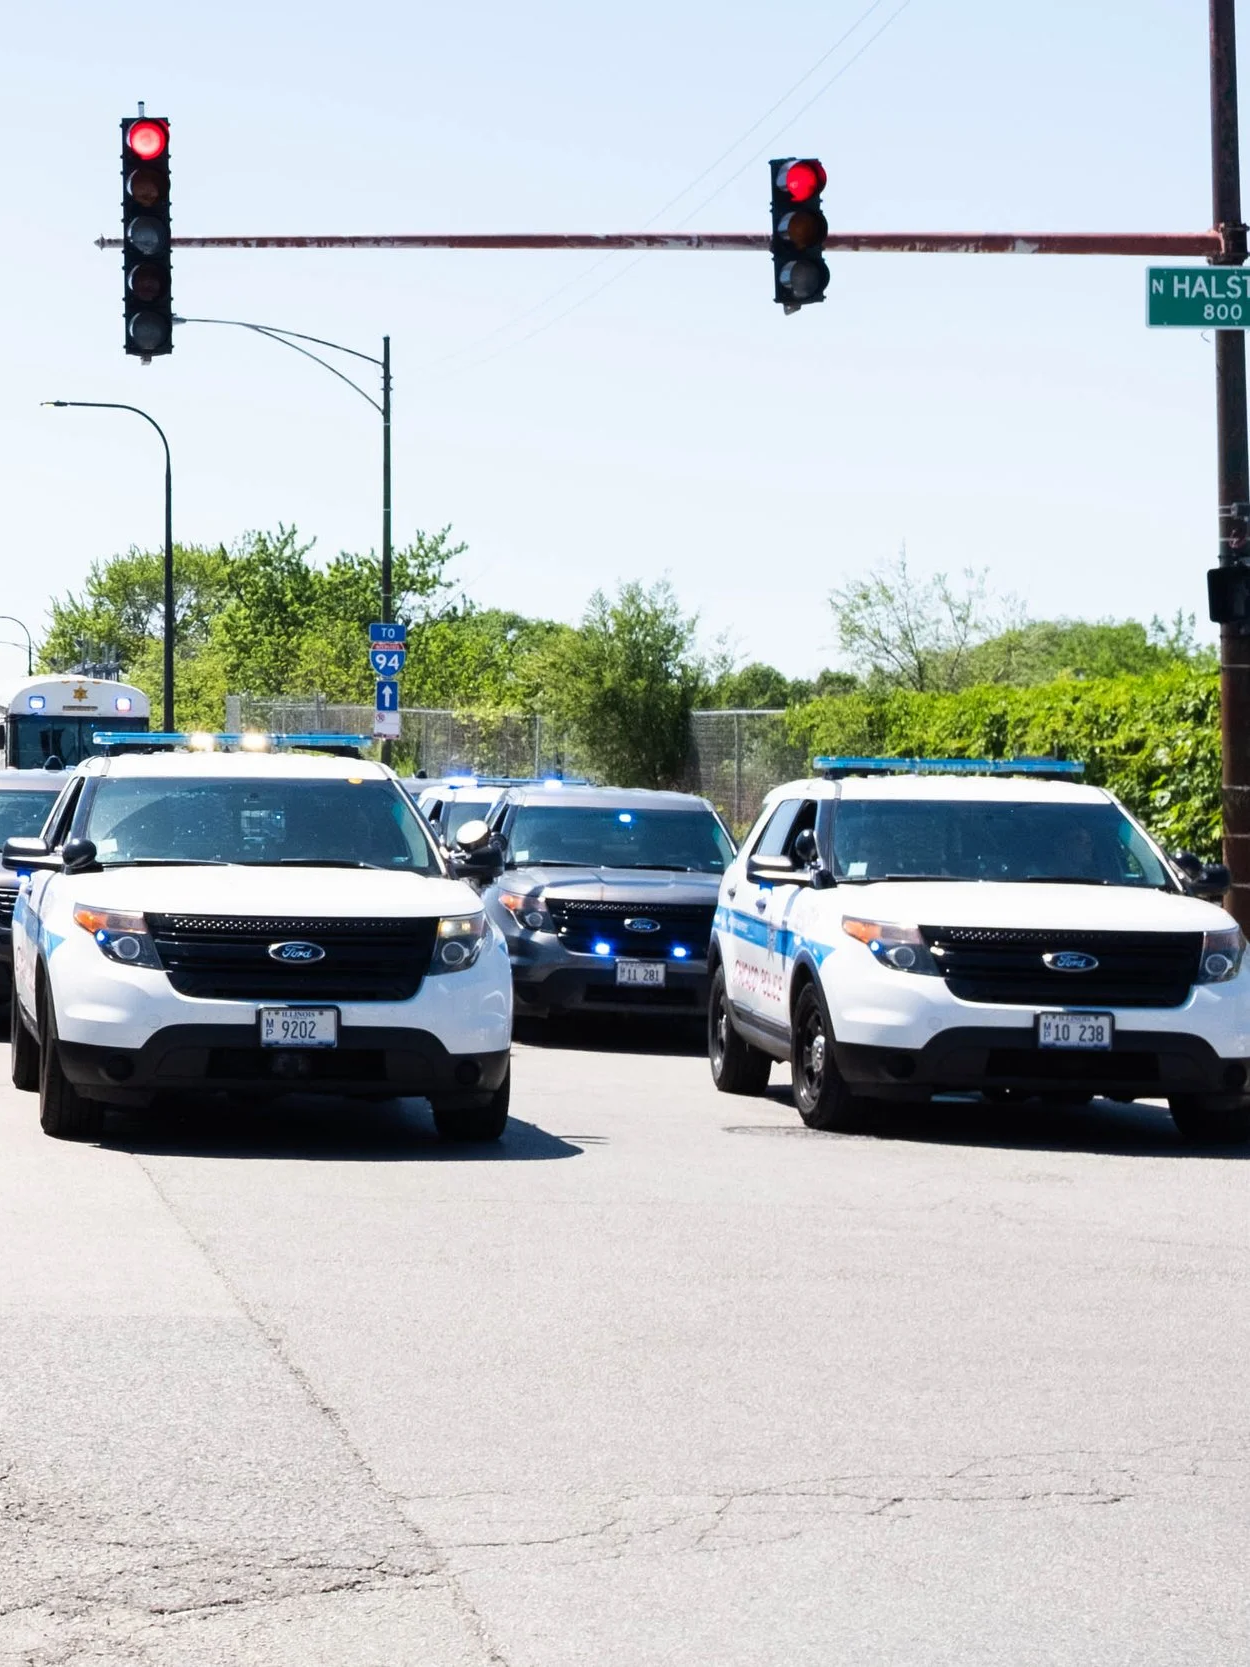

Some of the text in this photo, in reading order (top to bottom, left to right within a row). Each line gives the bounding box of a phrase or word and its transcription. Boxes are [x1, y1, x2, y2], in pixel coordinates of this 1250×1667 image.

[1152, 279, 1164, 294] N
[1203, 304, 1243, 320] 800
[381, 627, 396, 639] TO
[375, 653, 400, 671] 94
[627, 968, 638, 981] 11
[643, 969, 659, 982] 281
[282, 1020, 316, 1039] 9202
[1053, 1023, 1070, 1041] 10
[1079, 1024, 1104, 1042] 238
